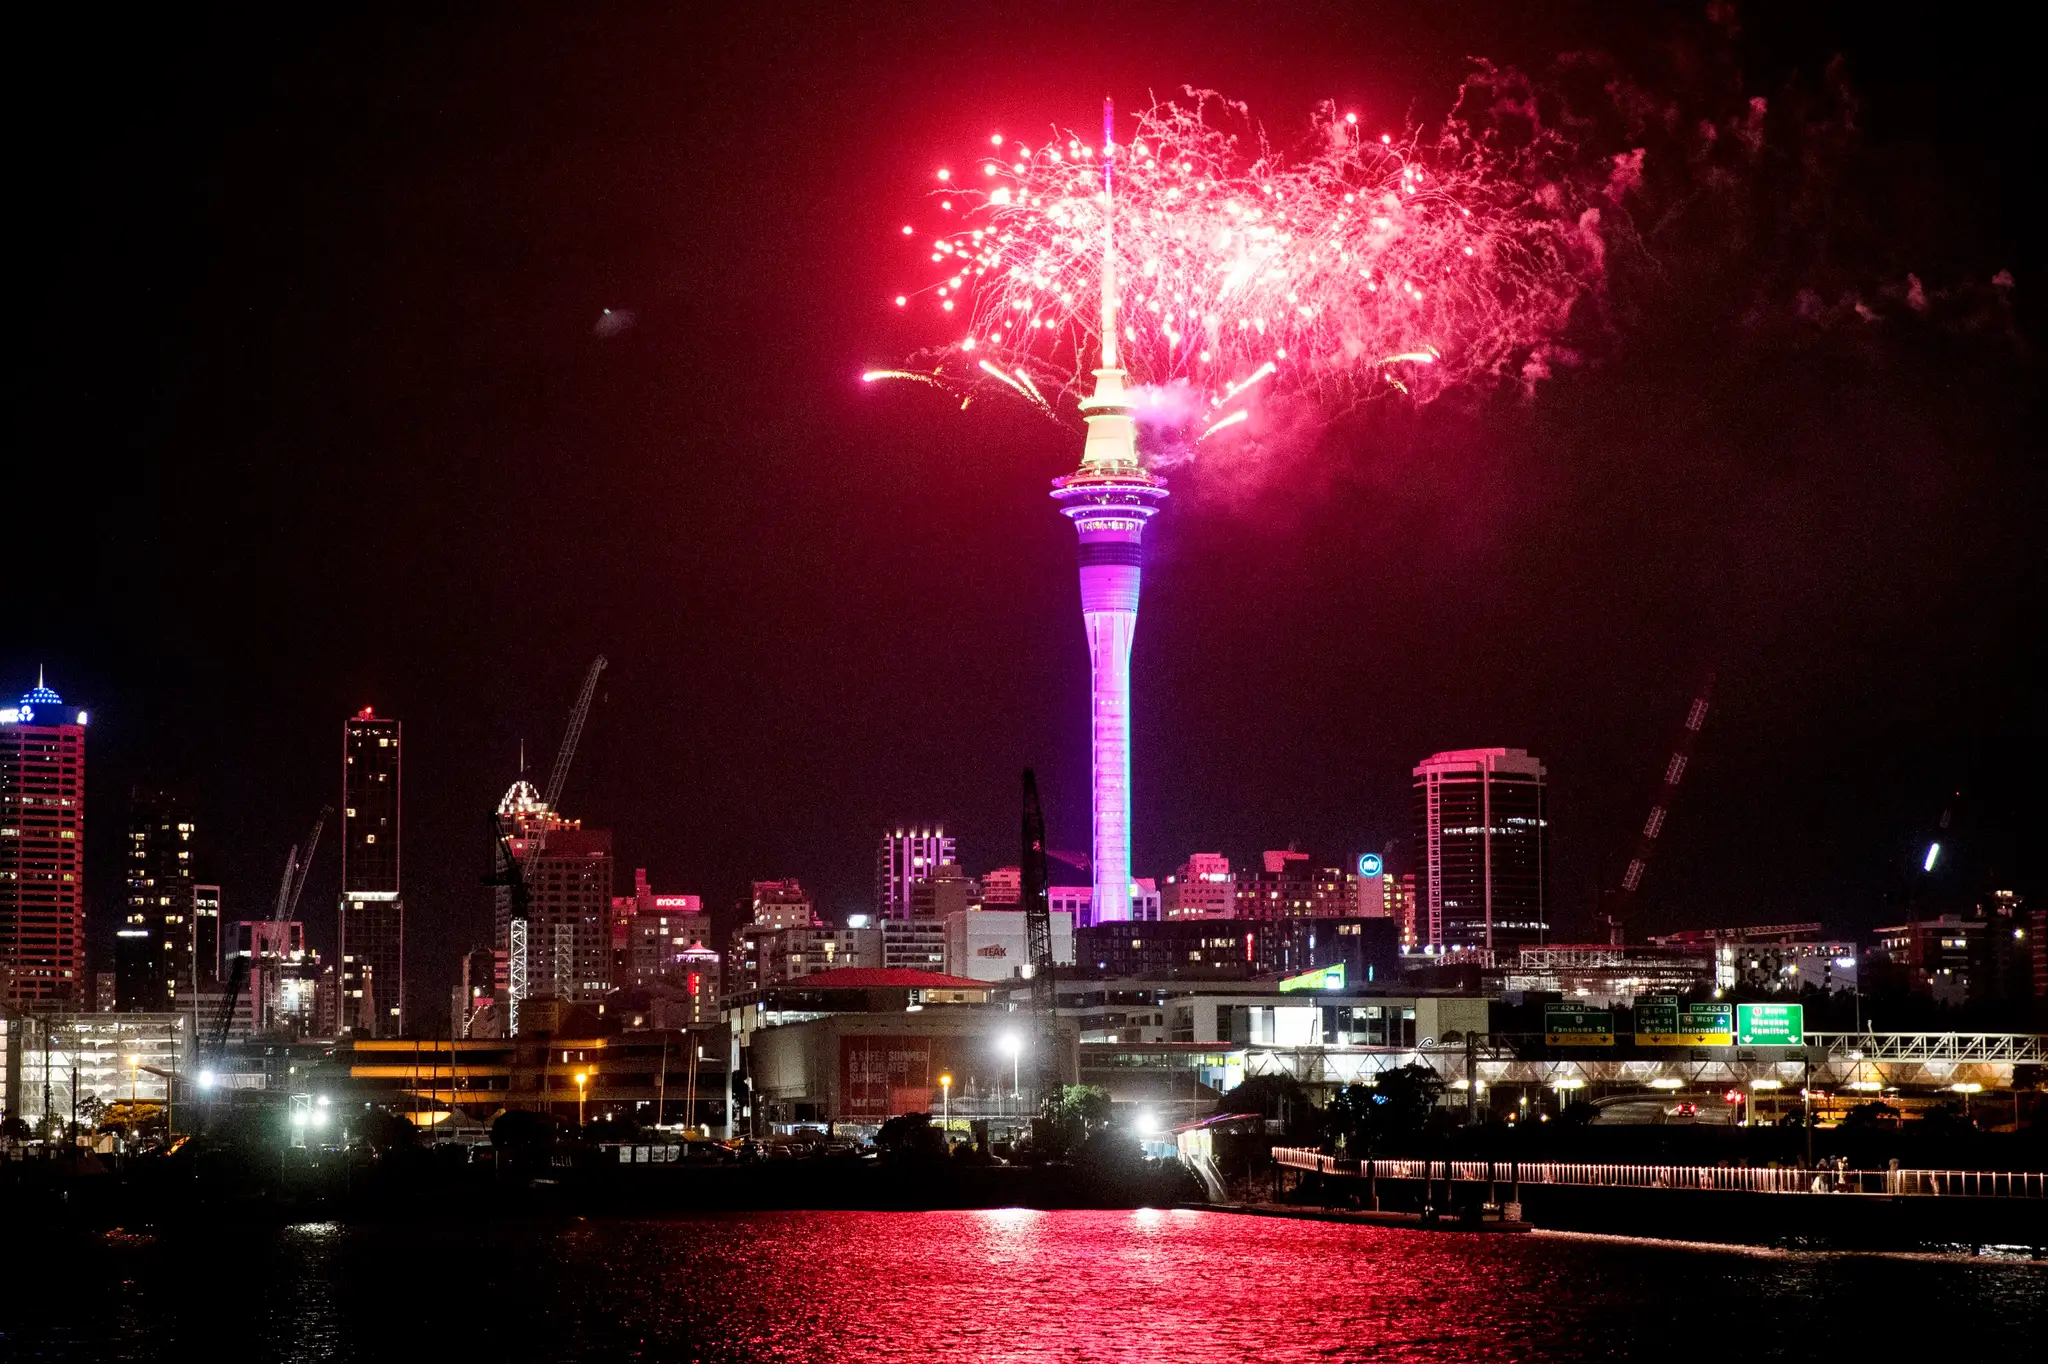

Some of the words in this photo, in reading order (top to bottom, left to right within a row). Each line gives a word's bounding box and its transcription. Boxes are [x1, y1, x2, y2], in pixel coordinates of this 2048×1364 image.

[1640, 1017, 1660, 1025] Cook
[1663, 1017, 1673, 1025] St
[10, 1021, 18, 1030] P
[1750, 1027, 1790, 1035] Hamilton
[888, 1051, 928, 1061] SUMMER
